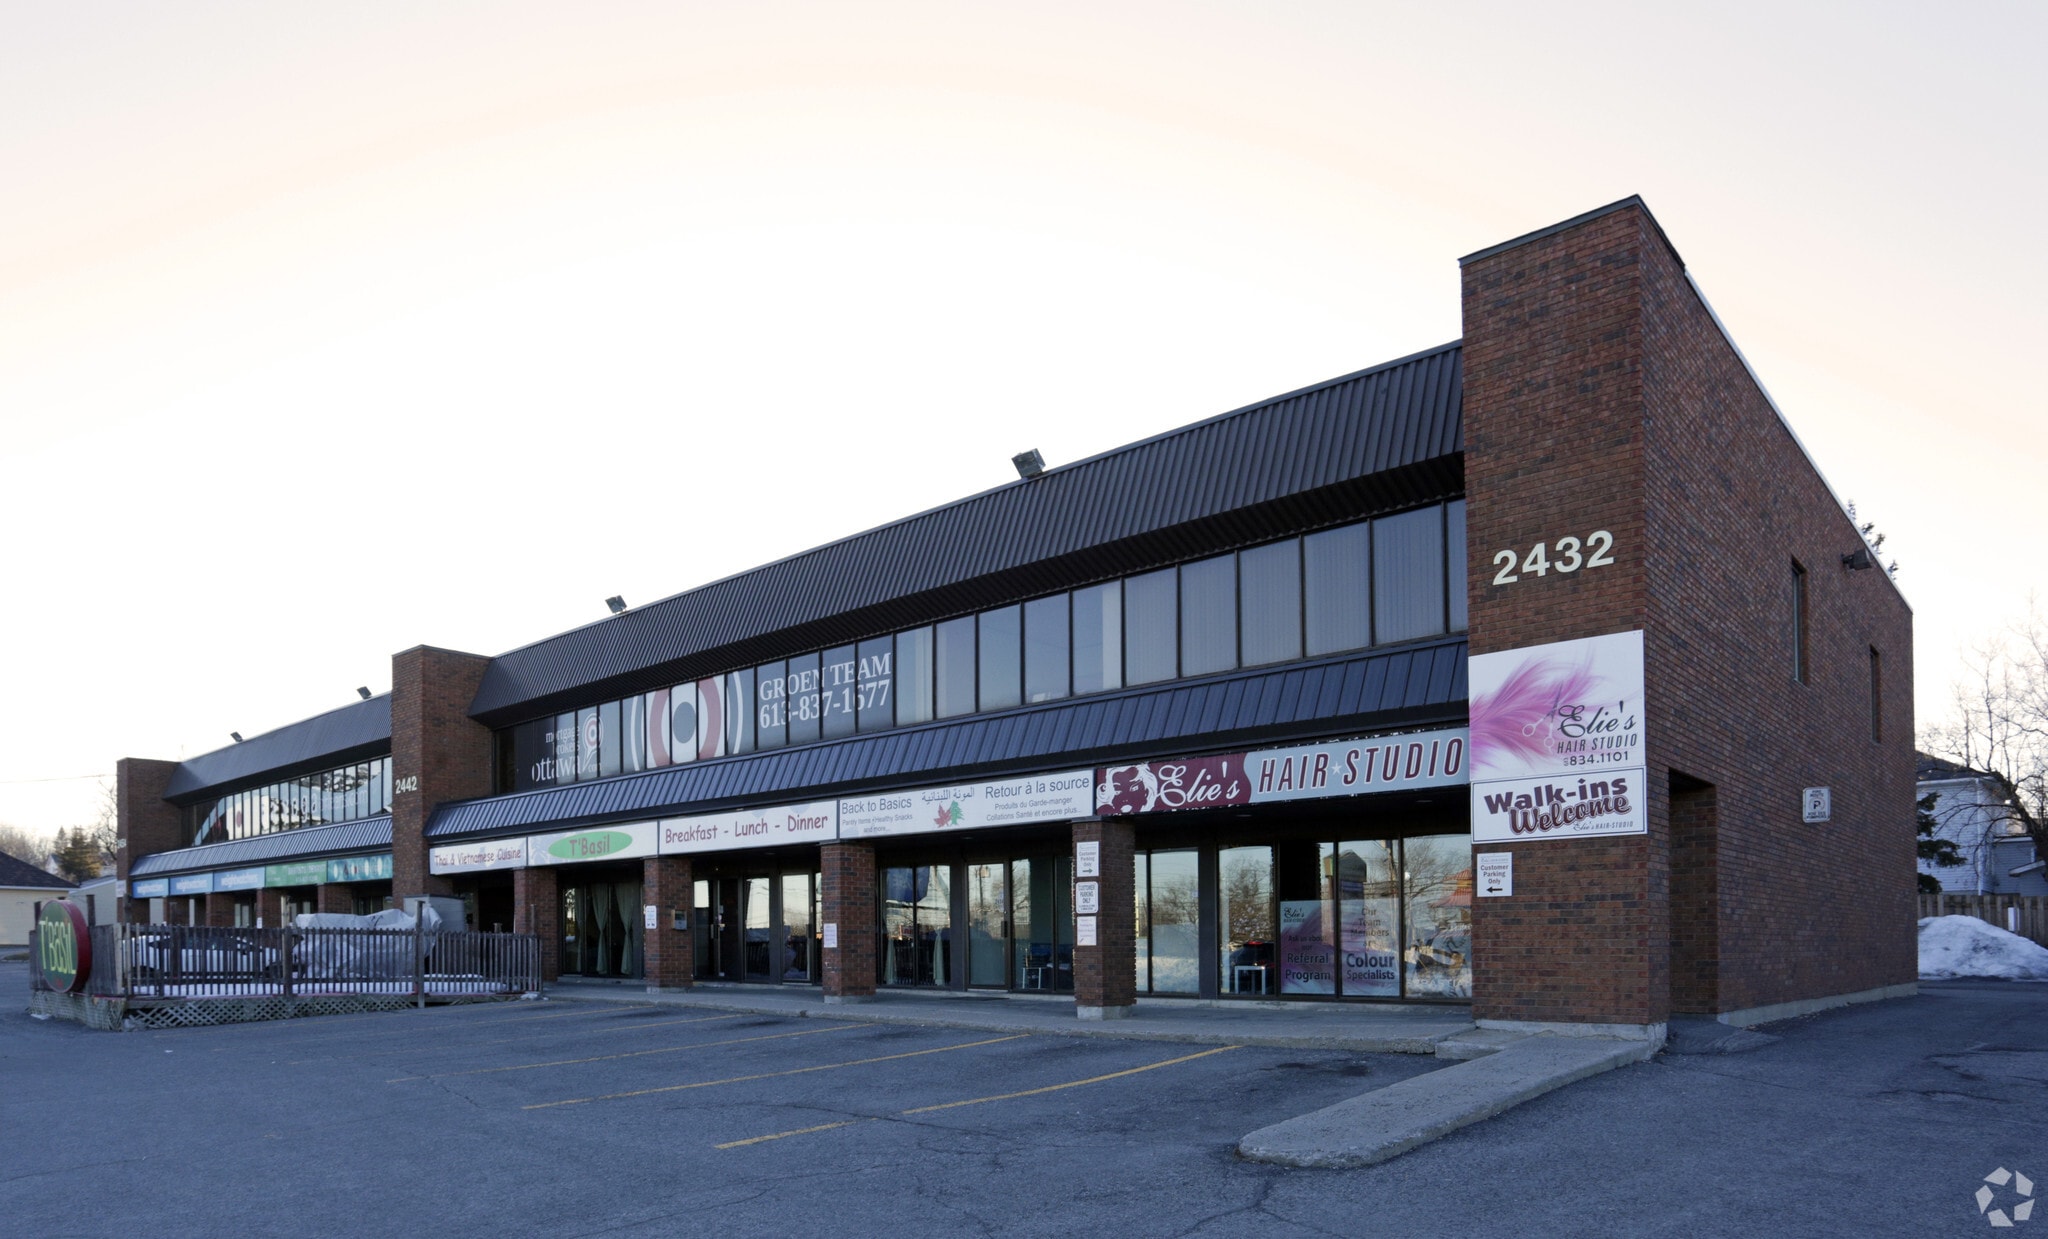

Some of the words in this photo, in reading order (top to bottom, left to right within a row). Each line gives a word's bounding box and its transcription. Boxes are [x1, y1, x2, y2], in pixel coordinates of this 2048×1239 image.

[1493, 530, 1614, 585] 2432
[760, 667, 826, 700] GROEN
[830, 652, 891, 686] TEAM
[760, 679, 890, 728] 613-837-1677
[1557, 700, 1637, 738] Elie's
[1557, 739, 1586, 754] HAIR
[1591, 734, 1637, 750] STUDIO
[1570, 751, 1628, 766] 834.1101
[1157, 760, 1240, 808] Elie's
[1258, 751, 1330, 794] HAIR
[1342, 737, 1464, 787] STUDIO
[395, 776, 418, 794] 2442
[985, 785, 1022, 799] Retour
[1025, 782, 1032, 795] à
[1036, 781, 1046, 793] la
[1049, 777, 1090, 791] source
[1020, 800, 1028, 809] du
[1484, 777, 1628, 815] Walk-ins
[841, 801, 865, 815] Back
[867, 800, 877, 813] to
[879, 798, 912, 811] Basics
[1508, 795, 1633, 835] Welcome
[665, 825, 718, 844] Breakfast
[734, 818, 769, 837] Lunch
[787, 815, 829, 832] Dinner
[569, 835, 611, 857] T'Basil
[434, 853, 449, 867] Thai
[457, 851, 495, 866] Vietnamese
[497, 847, 522, 861] Cuisine
[1483, 870, 1506, 878] Parking
[1488, 877, 1501, 885] Only
[1359, 918, 1381, 927] Team
[1287, 953, 1329, 964] Referral
[1346, 953, 1395, 968] Colour
[1285, 968, 1331, 982] Program
[1346, 969, 1395, 981] Specialists
